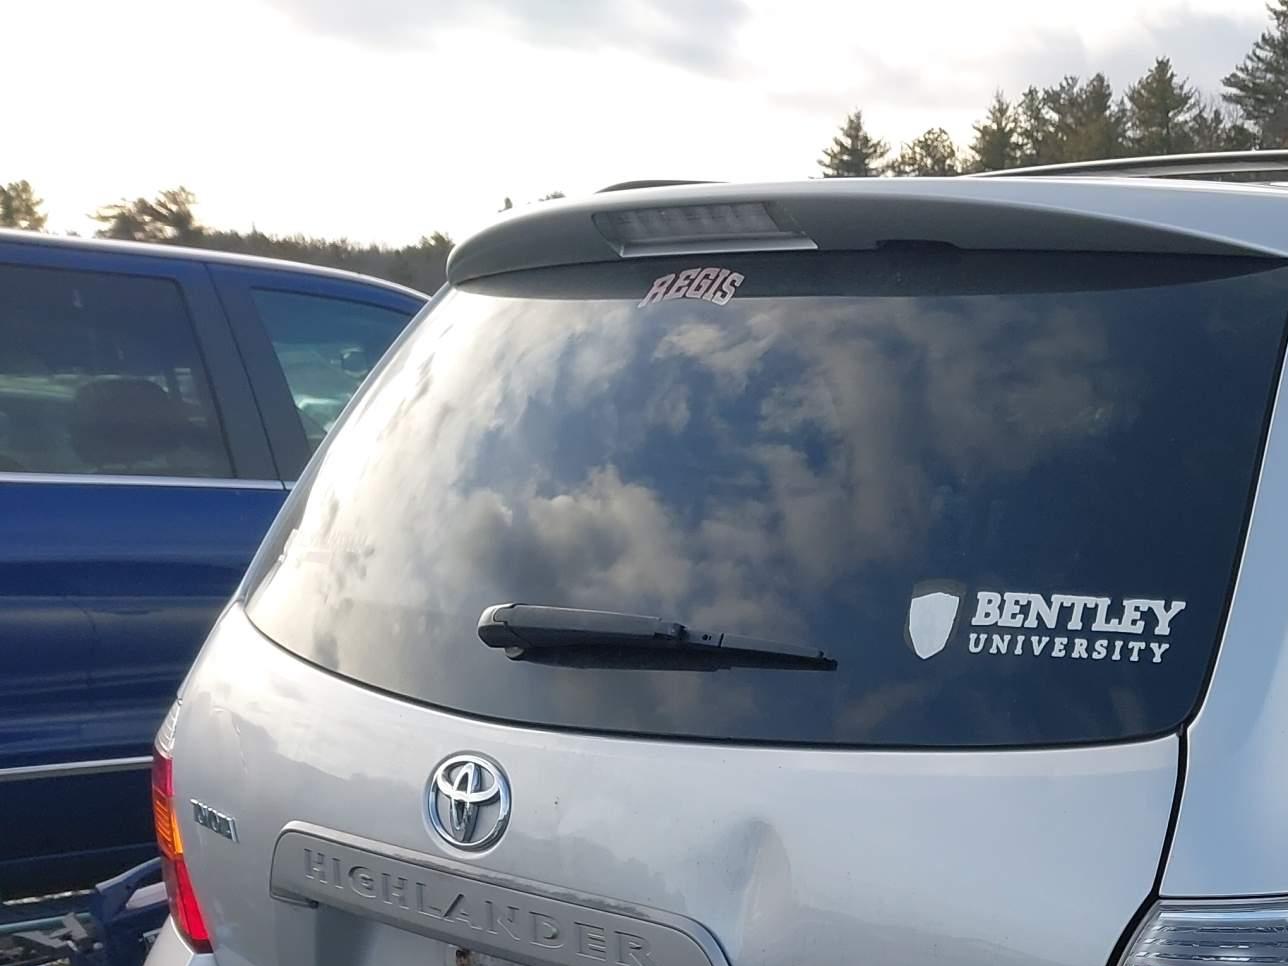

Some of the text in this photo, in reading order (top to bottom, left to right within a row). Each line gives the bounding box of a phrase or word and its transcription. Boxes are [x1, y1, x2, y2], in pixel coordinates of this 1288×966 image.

[637, 267, 745, 308] REGIS
[970, 591, 1186, 635] BENTLEY
[967, 632, 1169, 663] UNIVERSITY
